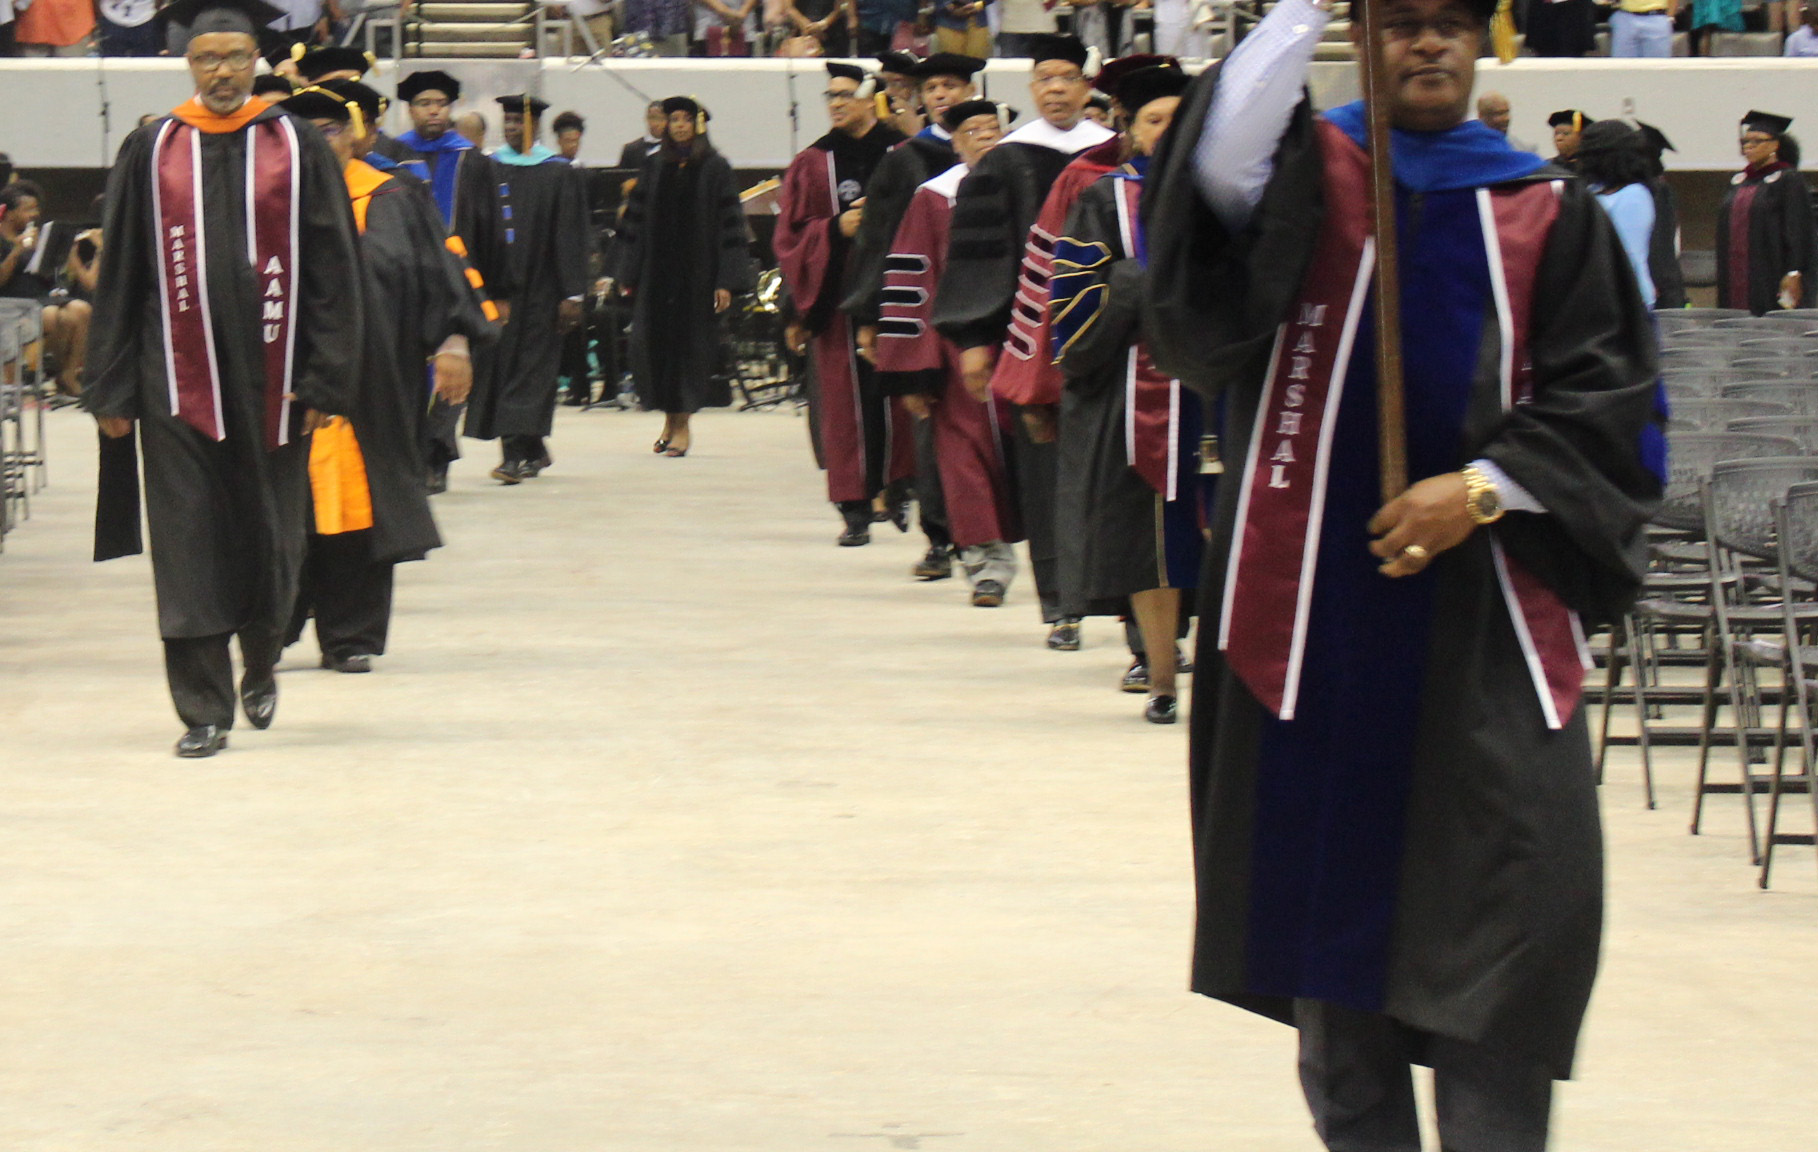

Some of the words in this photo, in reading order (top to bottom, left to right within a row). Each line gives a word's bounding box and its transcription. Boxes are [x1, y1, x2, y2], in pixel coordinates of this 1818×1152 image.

[168, 224, 191, 313] MARSHAL
[262, 255, 285, 344] AAMU
[1267, 303, 1328, 489] MARSHAL
